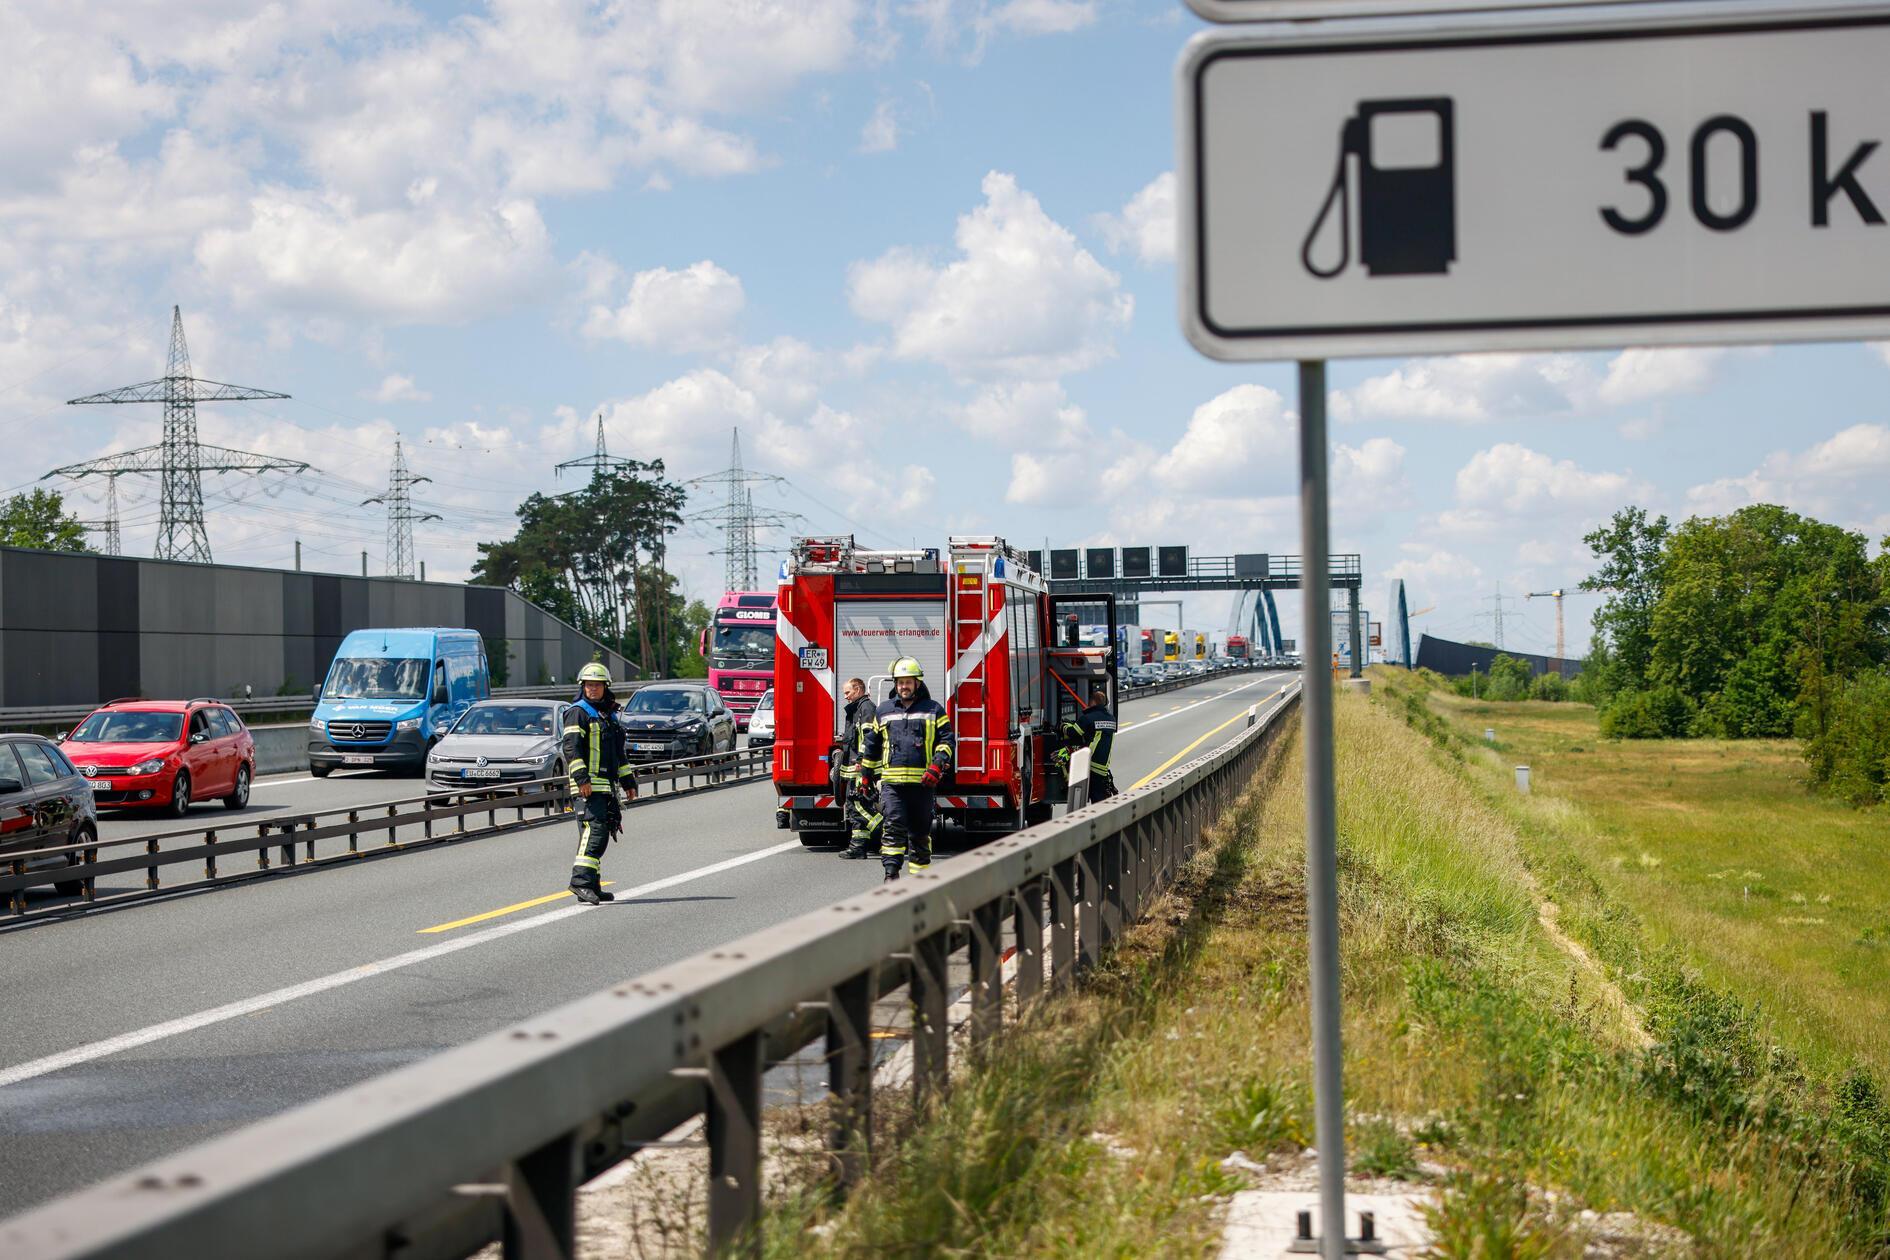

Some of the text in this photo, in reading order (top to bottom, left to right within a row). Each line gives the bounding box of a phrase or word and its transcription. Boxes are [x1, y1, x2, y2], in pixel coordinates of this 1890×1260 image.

[1598, 115, 1760, 237] 30
[735, 611, 771, 620] GLOMB
[841, 628, 940, 638] www.feuerwehr-erlangen.de
[806, 649, 817, 659] ER
[801, 658, 825, 667] FW 49
